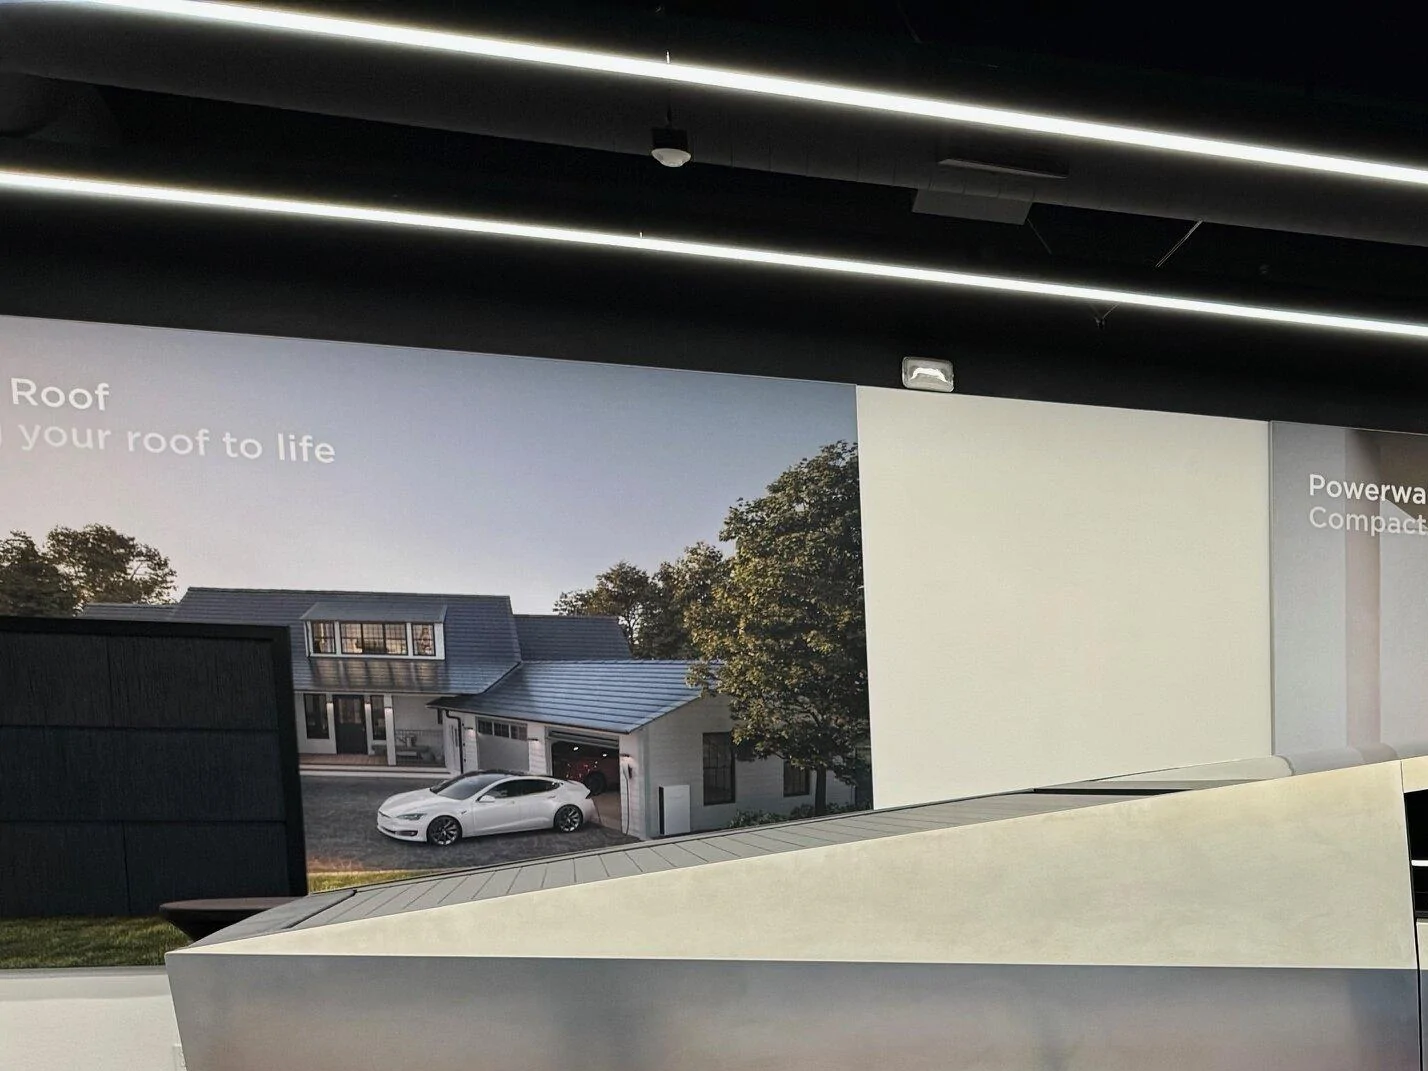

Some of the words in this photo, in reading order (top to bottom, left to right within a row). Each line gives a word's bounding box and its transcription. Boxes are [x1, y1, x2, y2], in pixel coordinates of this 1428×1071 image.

[11, 377, 110, 411] Roof
[18, 424, 112, 451] your
[127, 429, 210, 456] roof
[223, 432, 263, 460] to
[278, 433, 335, 463] life
[1309, 506, 1427, 536] Compact
